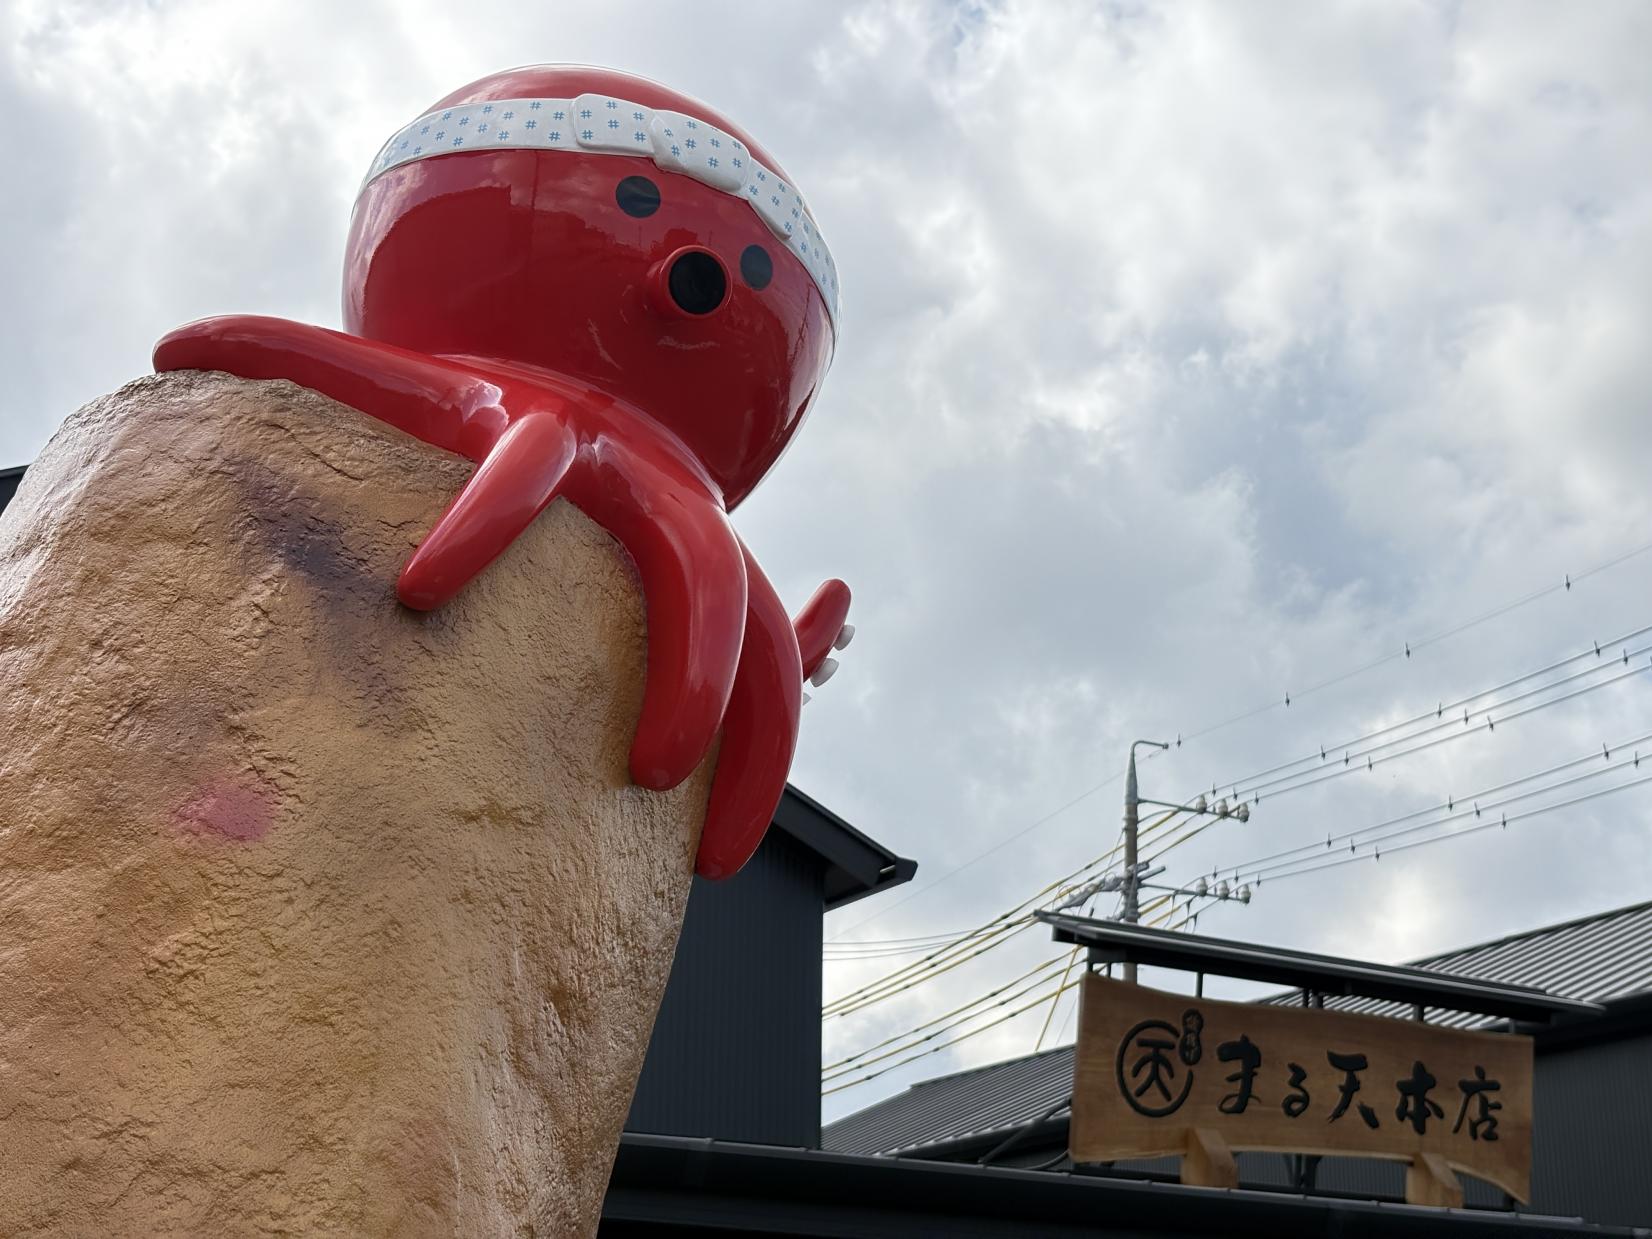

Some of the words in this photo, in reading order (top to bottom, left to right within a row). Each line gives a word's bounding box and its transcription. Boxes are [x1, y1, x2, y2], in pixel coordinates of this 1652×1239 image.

[1217, 1035, 1503, 1141] まる天本店
